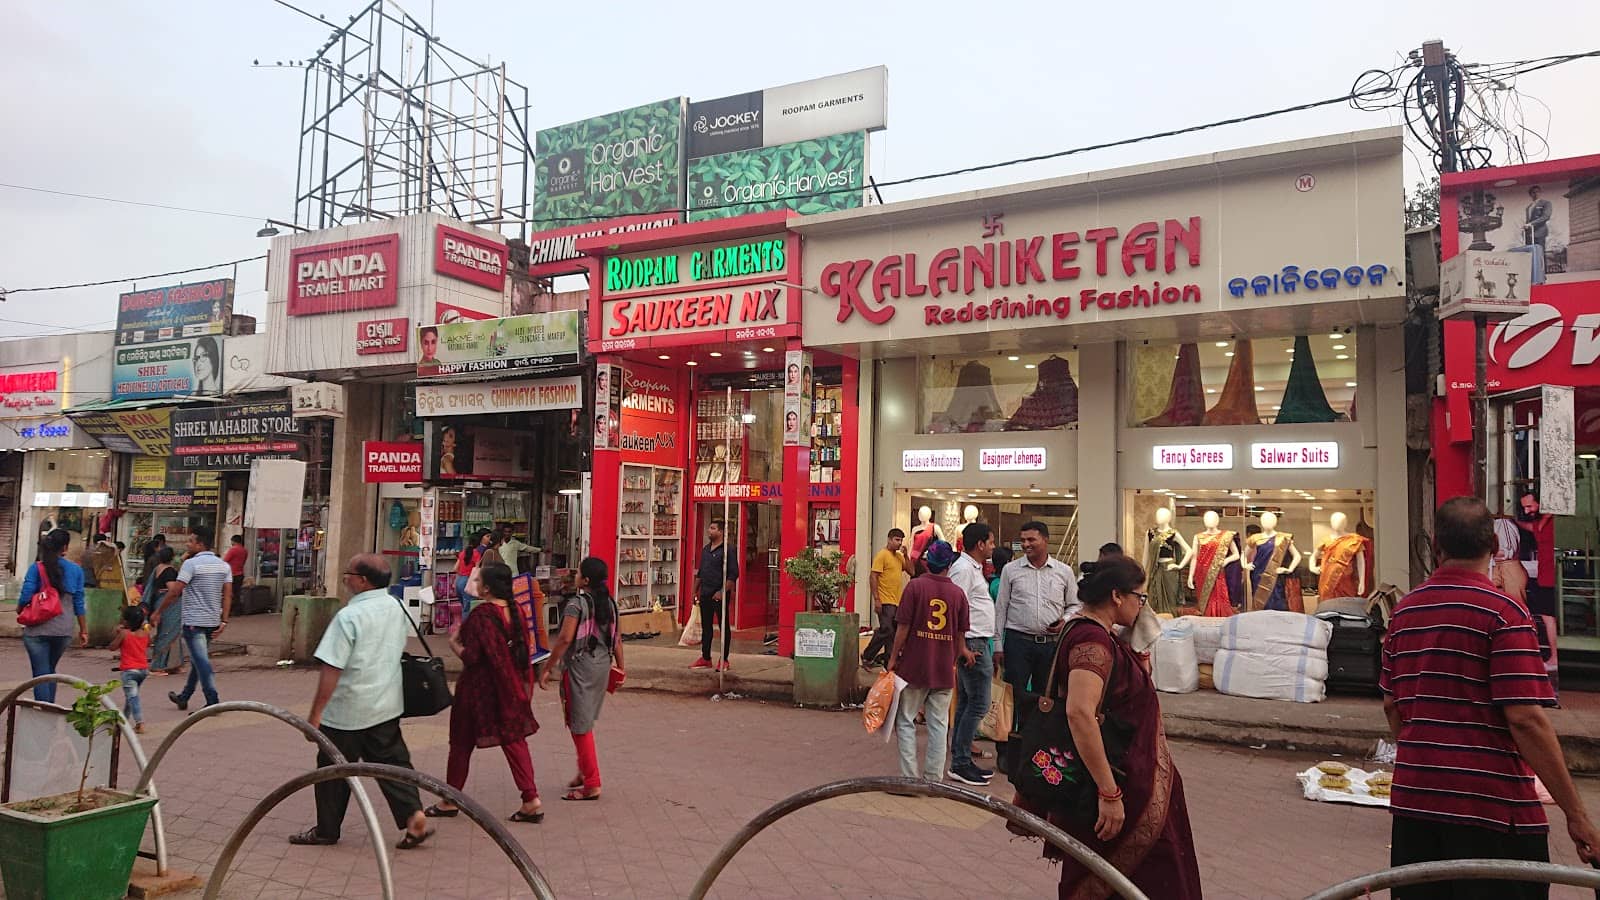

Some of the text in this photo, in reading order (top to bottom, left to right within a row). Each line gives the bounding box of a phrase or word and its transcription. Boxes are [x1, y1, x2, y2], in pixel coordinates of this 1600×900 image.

[782, 94, 865, 116] ROOPAM GARMENTS
[710, 110, 760, 129] JOCKEY
[591, 126, 664, 167] Organic
[590, 159, 664, 194] Harvest
[724, 167, 855, 203] Organic Harvest
[444, 237, 502, 268] PANDA
[297, 250, 386, 283] PANDA
[444, 252, 503, 276] TRAVEL MART
[606, 240, 785, 291] ROOPAM GARMENTS
[820, 216, 1203, 326] KALANIKETAN
[298, 275, 385, 298] TRAVEL MART
[1228, 264, 1388, 299] କଳାନିକେତନ
[609, 288, 781, 337] SAUKEEN NX
[924, 282, 1202, 327] Redefining Fashion
[138, 364, 168, 377] SHREE
[438, 360, 508, 374] HAPPY FASHION
[624, 369, 671, 394] Roopam
[491, 384, 577, 408] CHINMAYA FASHION
[622, 393, 675, 414] ARMENTS
[119, 413, 161, 426] SKIN
[174, 416, 299, 438] SHREE MAHABIR STORE
[621, 431, 676, 452] aukeen NX
[207, 453, 250, 466] LAKMÉ
[368, 452, 421, 463] PANDA
[904, 454, 929, 468] Exclusive
[982, 450, 1042, 467] Designer Lehenga
[1161, 449, 1224, 467] Fancy Sarees
[1260, 447, 1329, 463] Salwar Suits
[368, 465, 421, 473] TRAVEL MART
[693, 485, 717, 497] ROOPAM
[927, 599, 948, 630] 3
